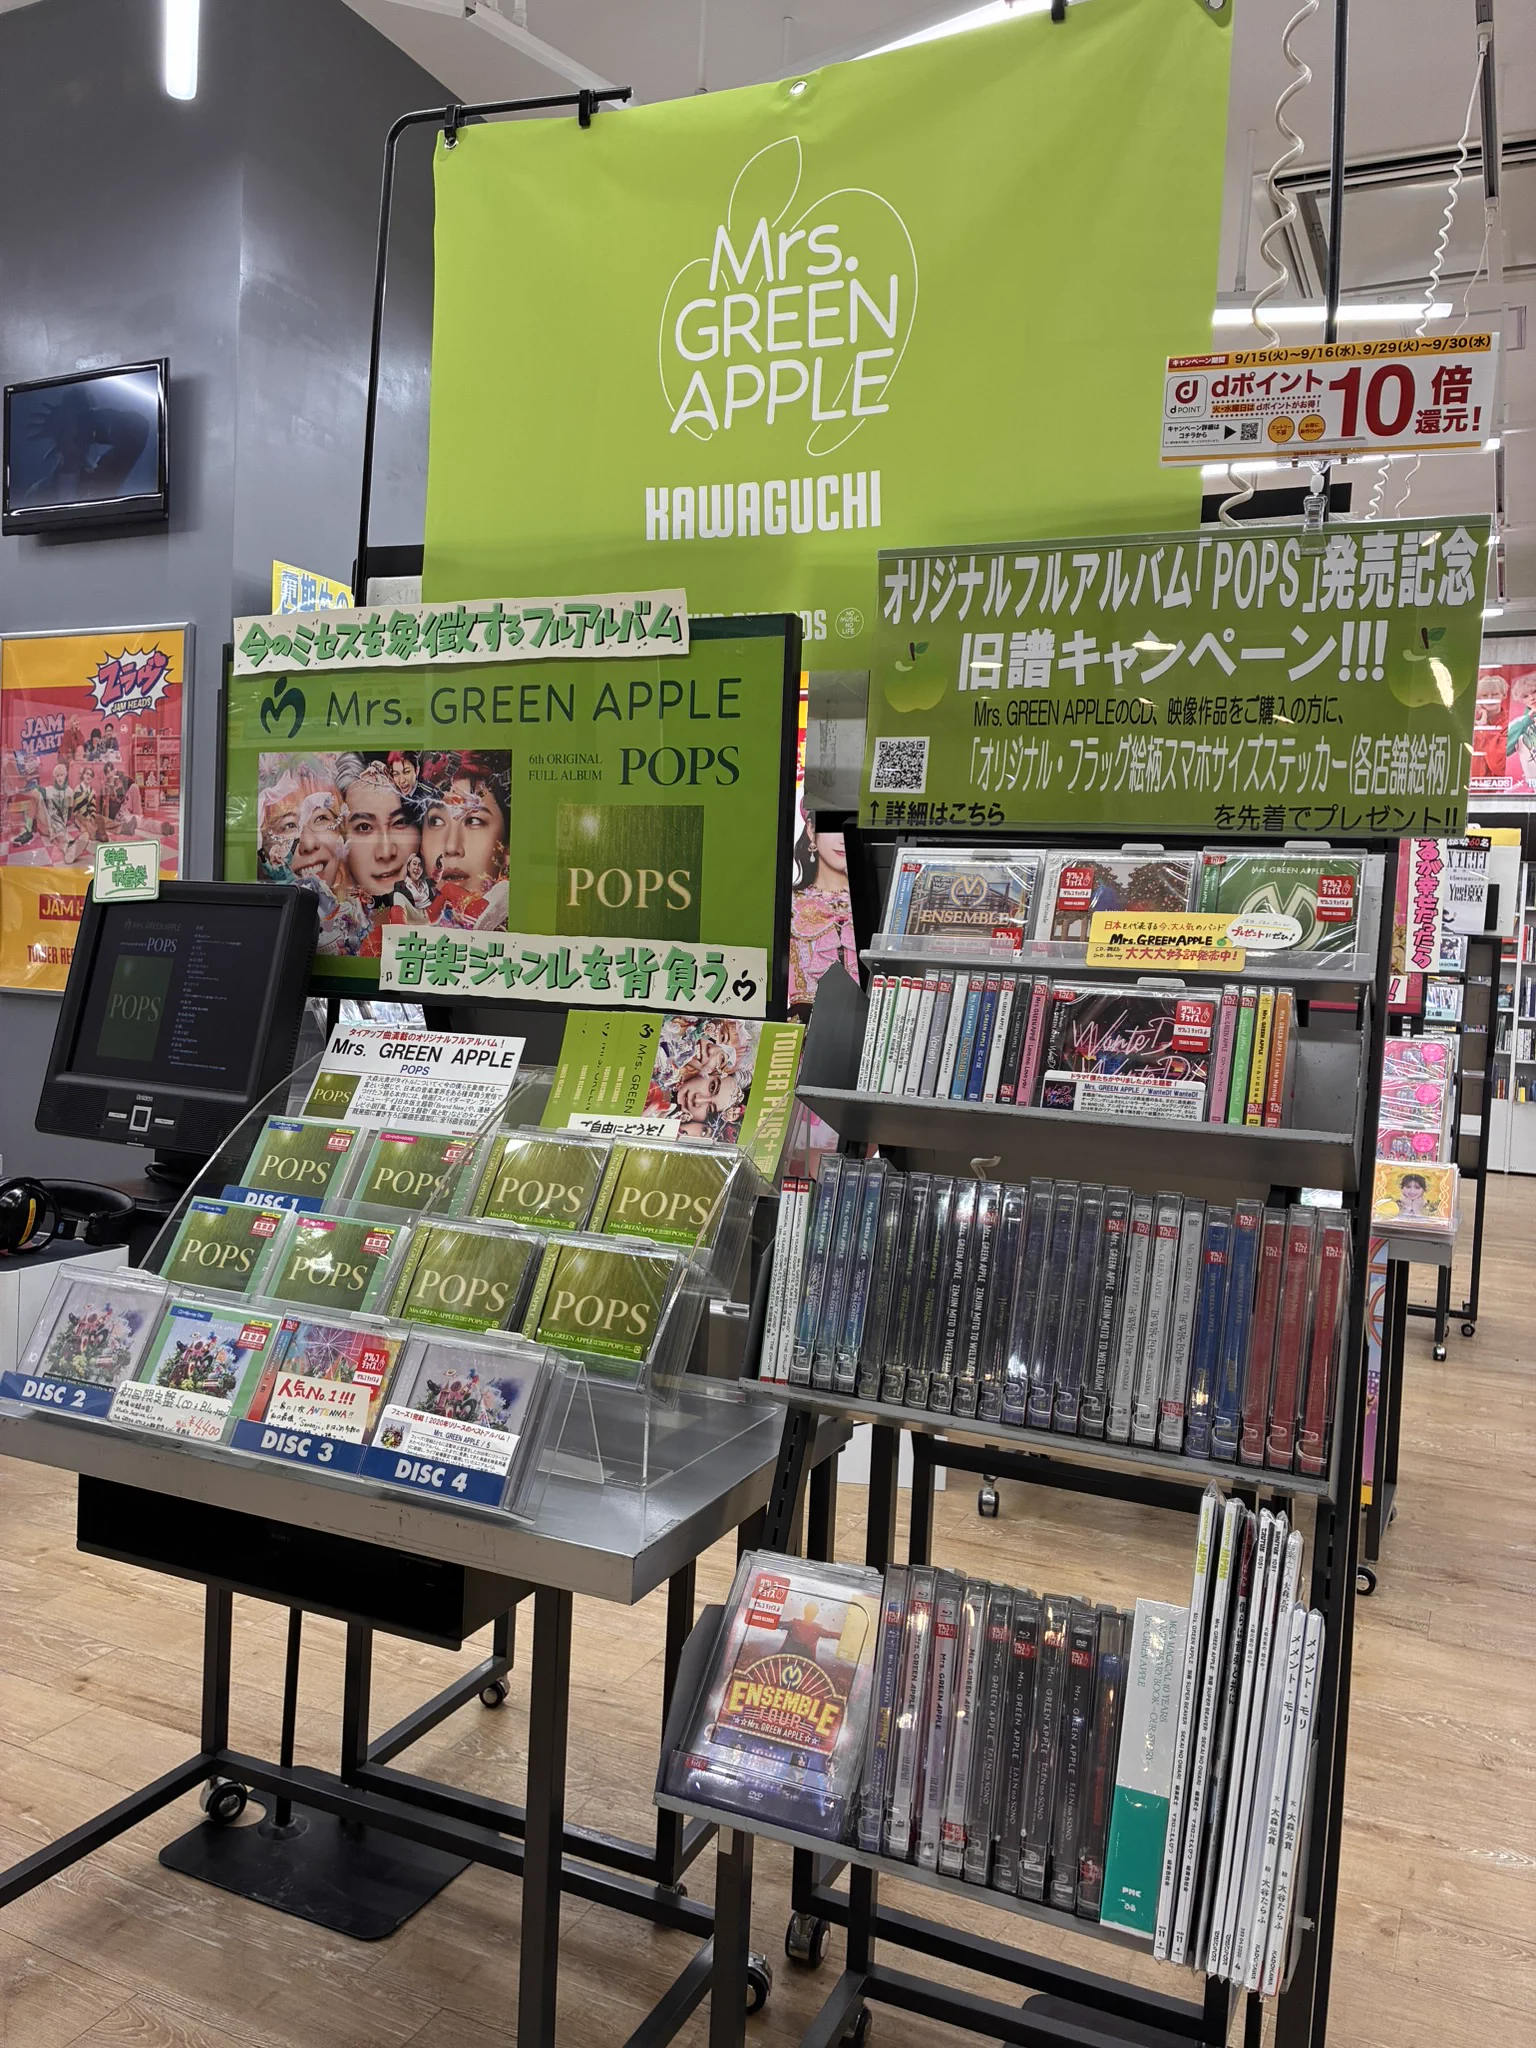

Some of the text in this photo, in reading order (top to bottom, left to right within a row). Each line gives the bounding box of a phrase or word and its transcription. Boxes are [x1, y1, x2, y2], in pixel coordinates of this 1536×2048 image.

[709, 217, 859, 291] Mrs.
[675, 274, 898, 361] GREEN
[1172, 356, 1227, 368] キャンペーン期間
[670, 347, 894, 434] APPLE
[1211, 369, 1324, 398] dポイント
[1328, 364, 1416, 437] 10
[1431, 365, 1473, 405] 倍
[1178, 406, 1201, 414] POINT
[1415, 405, 1482, 435] 還元!
[646, 470, 882, 541] KAWAGUCHI
[883, 525, 1478, 626] オリジナルフルアルバム「POPS」発売記念
[239, 601, 683, 667] 今のミセスを象徴するフルアルバム
[958, 620, 1388, 691] 旧譜キャンペーン!!!
[112, 697, 152, 713] JAM HEADS
[326, 677, 743, 727] Mrs. GREEN APPLE
[974, 702, 1002, 727] Mrs.
[1006, 702, 1061, 726] GREEN
[21, 713, 65, 738] JAM
[21, 733, 63, 754] MART
[529, 752, 604, 767] 6th ORIGINAL
[528, 768, 604, 782] FULL ALBUM
[619, 745, 740, 787] POPS
[1215, 804, 1458, 834] を先着でプレゼント!!
[104, 847, 128, 866] 特典
[1251, 865, 1325, 875] Mrs. GREEN APPLE
[112, 865, 148, 888] 巾着袋
[567, 867, 692, 911] POPS
[42, 900, 74, 916] JAM
[920, 909, 1010, 925] ENSEMBLE
[146, 937, 178, 953] POPS
[395, 931, 728, 1004] 音楽ジャンルを背負う
[109, 993, 162, 1022] POPS
[1180, 1006, 1201, 1015] タワレコ
[1180, 1013, 1200, 1022] チョイス
[331, 1038, 515, 1069] Mrs. GREEN APPLE
[765, 1029, 799, 1091] TOWER
[928, 1035, 940, 1065] Variety
[400, 1064, 430, 1076] POPS
[624, 1043, 648, 1114] Mrs. GREEN
[314, 1088, 351, 1103] POPS
[259, 1154, 331, 1185] POPS
[373, 1167, 450, 1198] POPS
[245, 1191, 300, 1213] DISC 1
[495, 1176, 584, 1213] POPS
[617, 1186, 711, 1225] POPS
[180, 1239, 255, 1273] POPS
[288, 1255, 368, 1291] POPS
[416, 1269, 509, 1313] POPS
[946, 1239, 967, 1337] GREEN APPLE MITO TO
[970, 1241, 990, 1341] GREEN APPLE MITO TO
[1131, 1251, 1143, 1297] GREEN APPLE
[1154, 1253, 1166, 1300] GREEN APPLE
[1182, 1257, 1194, 1304] GREEN APPLE
[549, 1290, 650, 1336] POPS
[1098, 1247, 1119, 1349] GREEN APPLE ZENJIN MITO TO
[22, 1379, 86, 1408] DISC 2
[260, 1429, 333, 1462] DISC 3
[446, 1432, 479, 1446] GREEN APPLE
[394, 1458, 467, 1492] DISC 4
[1196, 1542, 1208, 1576] JAPAN
[1273, 1531, 1281, 1556] BRUTUS
[1218, 1547, 1231, 1580] JAPAN
[1212, 1630, 1220, 1651] GREEN
[1137, 1630, 1149, 1687] GREEN APPLE
[908, 1653, 920, 1710] GREEN APPLE
[937, 1673, 945, 1700] GREEN
[963, 1668, 974, 1725] GREEN APPLE
[1283, 1635, 1301, 1726] メメント・モリ
[1299, 1639, 1317, 1730] メメント・モリ
[728, 1680, 839, 1736] ENSEMBLE
[759, 1706, 802, 1728] TOUR
[935, 1701, 943, 1730] APPLE
[986, 1676, 999, 1741] GREEN APPLE
[1040, 1689, 1053, 1754] GREEN APPLE
[1159, 1694, 1169, 1723] YEARS
[747, 1719, 804, 1741] Mrs. GREEN APPLE
[1011, 1694, 1023, 1760] GREEN APPLE
[1068, 1708, 1080, 1775] GREEN APPLE
[1267, 1808, 1280, 1847] 大森元貴
[1284, 1812, 1297, 1851] 大森元貴
[1122, 1886, 1142, 1898] PMC
[1257, 1878, 1272, 1924] 大谷たらふ
[1273, 1883, 1288, 1931] 大谷たらふ
[1250, 1944, 1261, 1981] KADOKAWA
[1267, 1949, 1278, 1986] KADOKAWA
